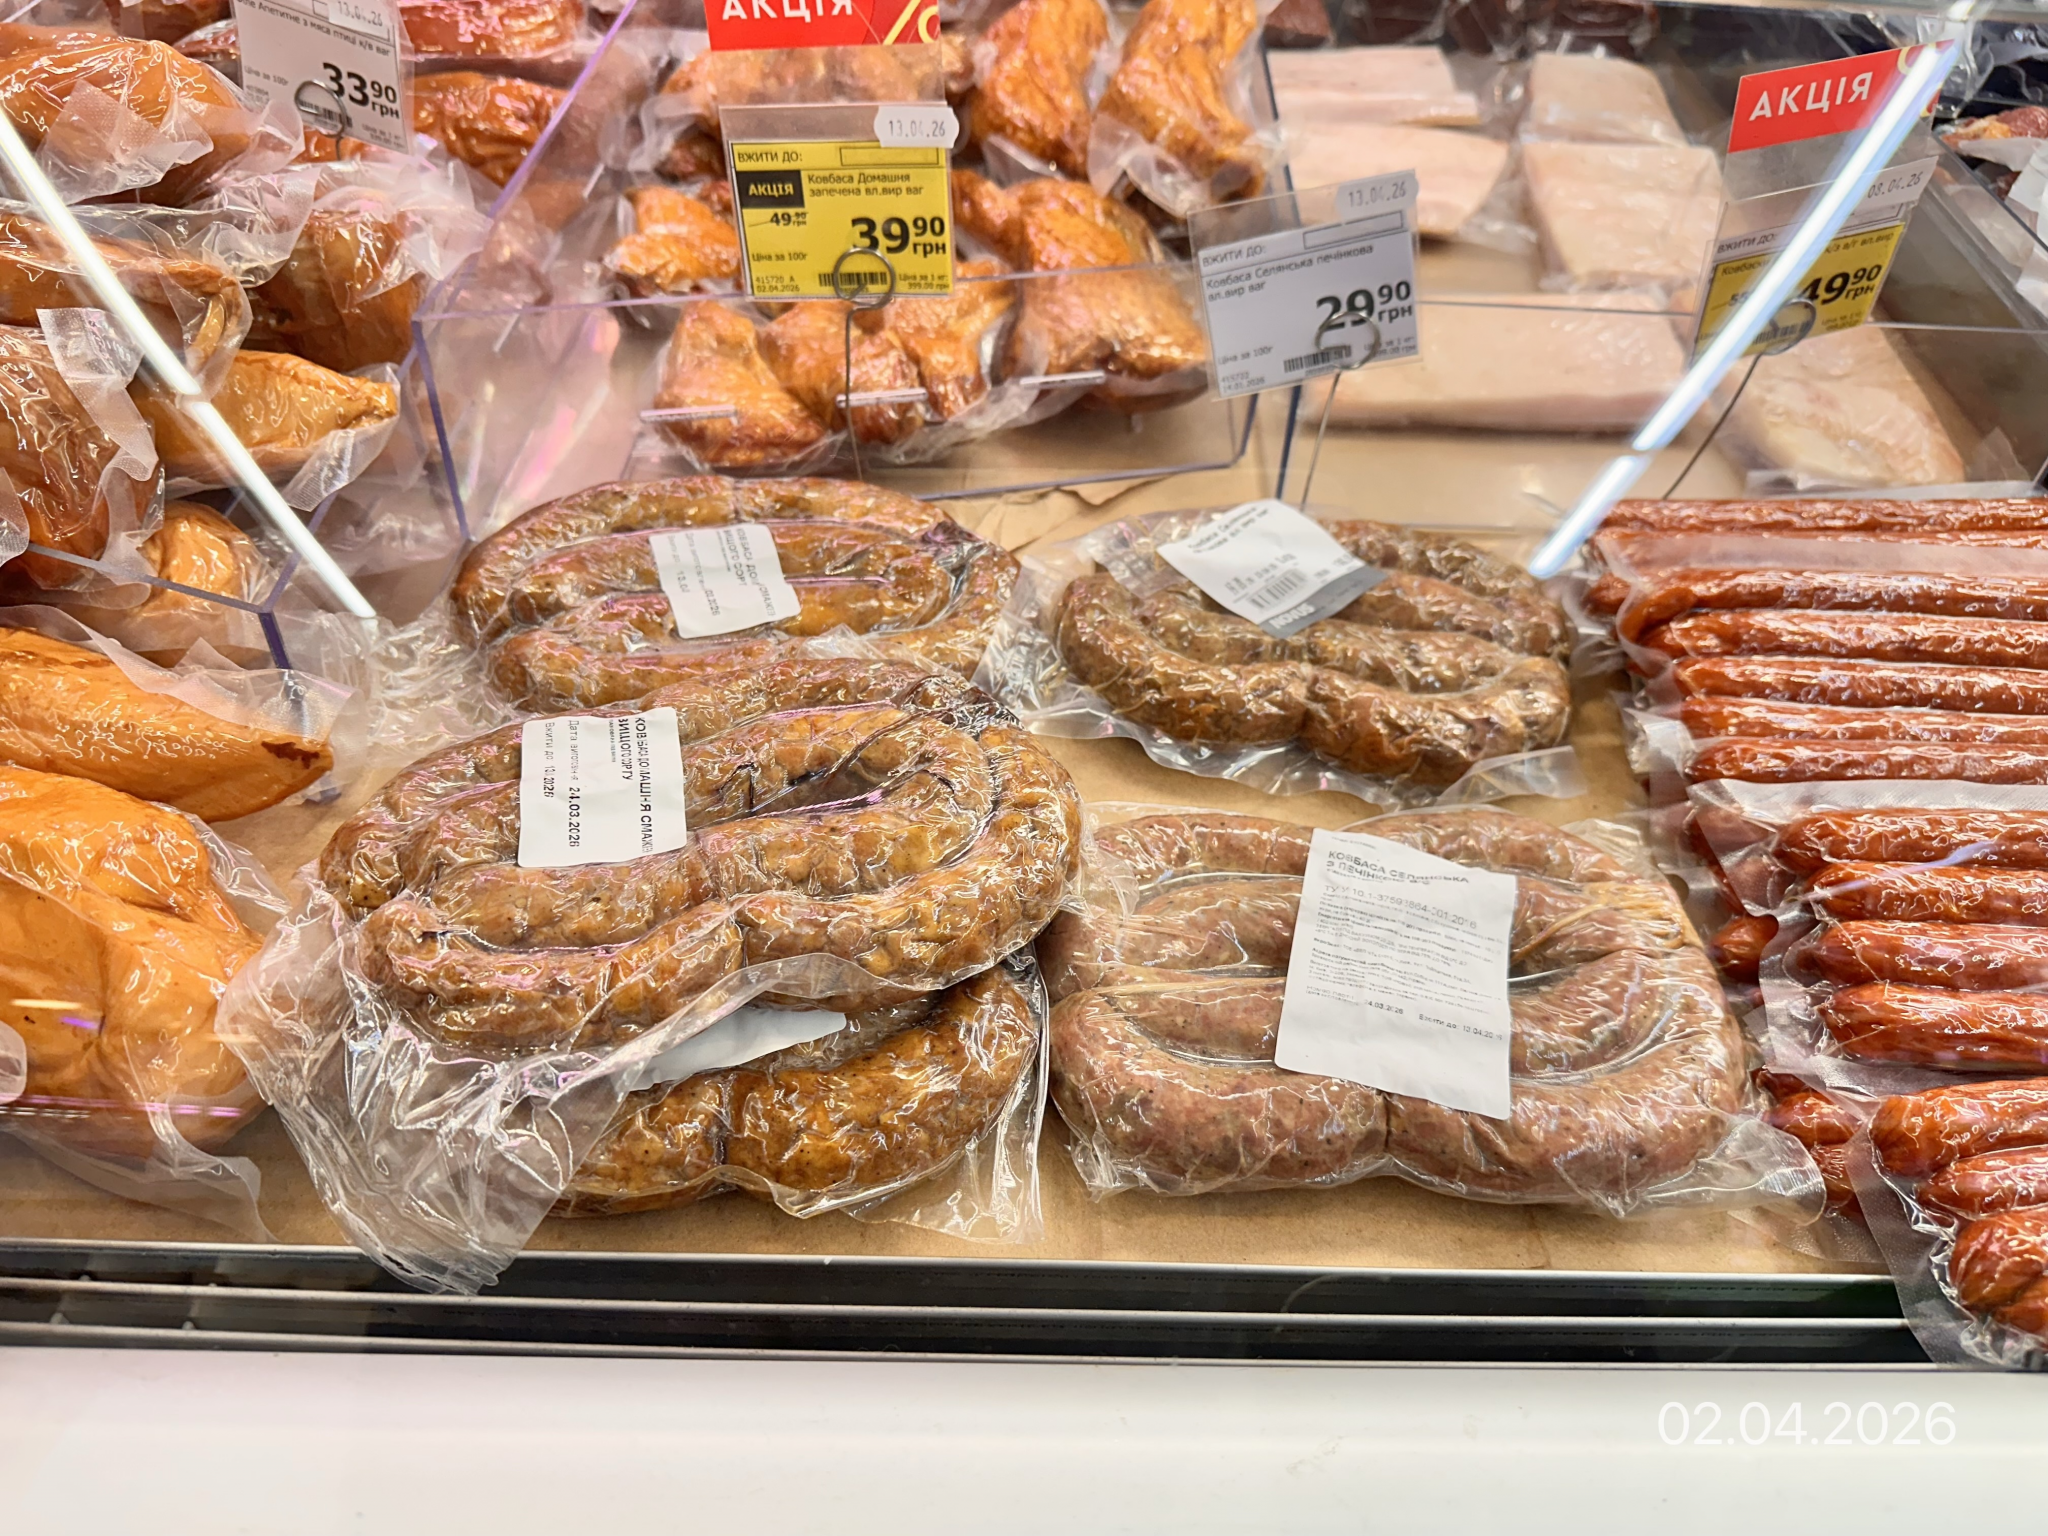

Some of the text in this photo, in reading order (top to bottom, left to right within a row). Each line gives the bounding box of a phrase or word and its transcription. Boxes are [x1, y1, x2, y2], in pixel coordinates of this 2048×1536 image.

[258, 2, 300, 24] Апетитне
[721, 0, 853, 23] АКЦІЯ
[322, 62, 397, 107] 33 90
[1749, 71, 1874, 122] АКЦІЯ
[371, 101, 400, 119] грн
[738, 152, 803, 164] ВЖИТИ ДО:
[808, 173, 911, 186] Ковбаса Домашня
[749, 183, 795, 198] АКЦІЯ
[809, 187, 924, 198] запечена вл.вир ваг
[769, 212, 792, 226] 49
[851, 217, 945, 254] 39 90
[913, 242, 947, 258] грн
[1717, 238, 1756, 254] ВЖИТИ
[752, 252, 808, 263] Ціна за 100г
[1202, 244, 1267, 268] ВЖИТИ ДО:
[1206, 244, 1374, 290] Ковбаса Селянська печінкова
[1721, 260, 1769, 277] Ковбаск
[756, 284, 800, 293] 02.04.2026
[1248, 281, 1266, 292] ваг
[1801, 264, 1883, 306] 49 90
[1845, 285, 1875, 300] грн
[1316, 280, 1412, 331] 29 90
[1378, 304, 1413, 324] грн
[1267, 602, 1316, 630] NOVUS
[568, 720, 580, 741] Дата
[1328, 850, 1387, 875] КОВБАСА
